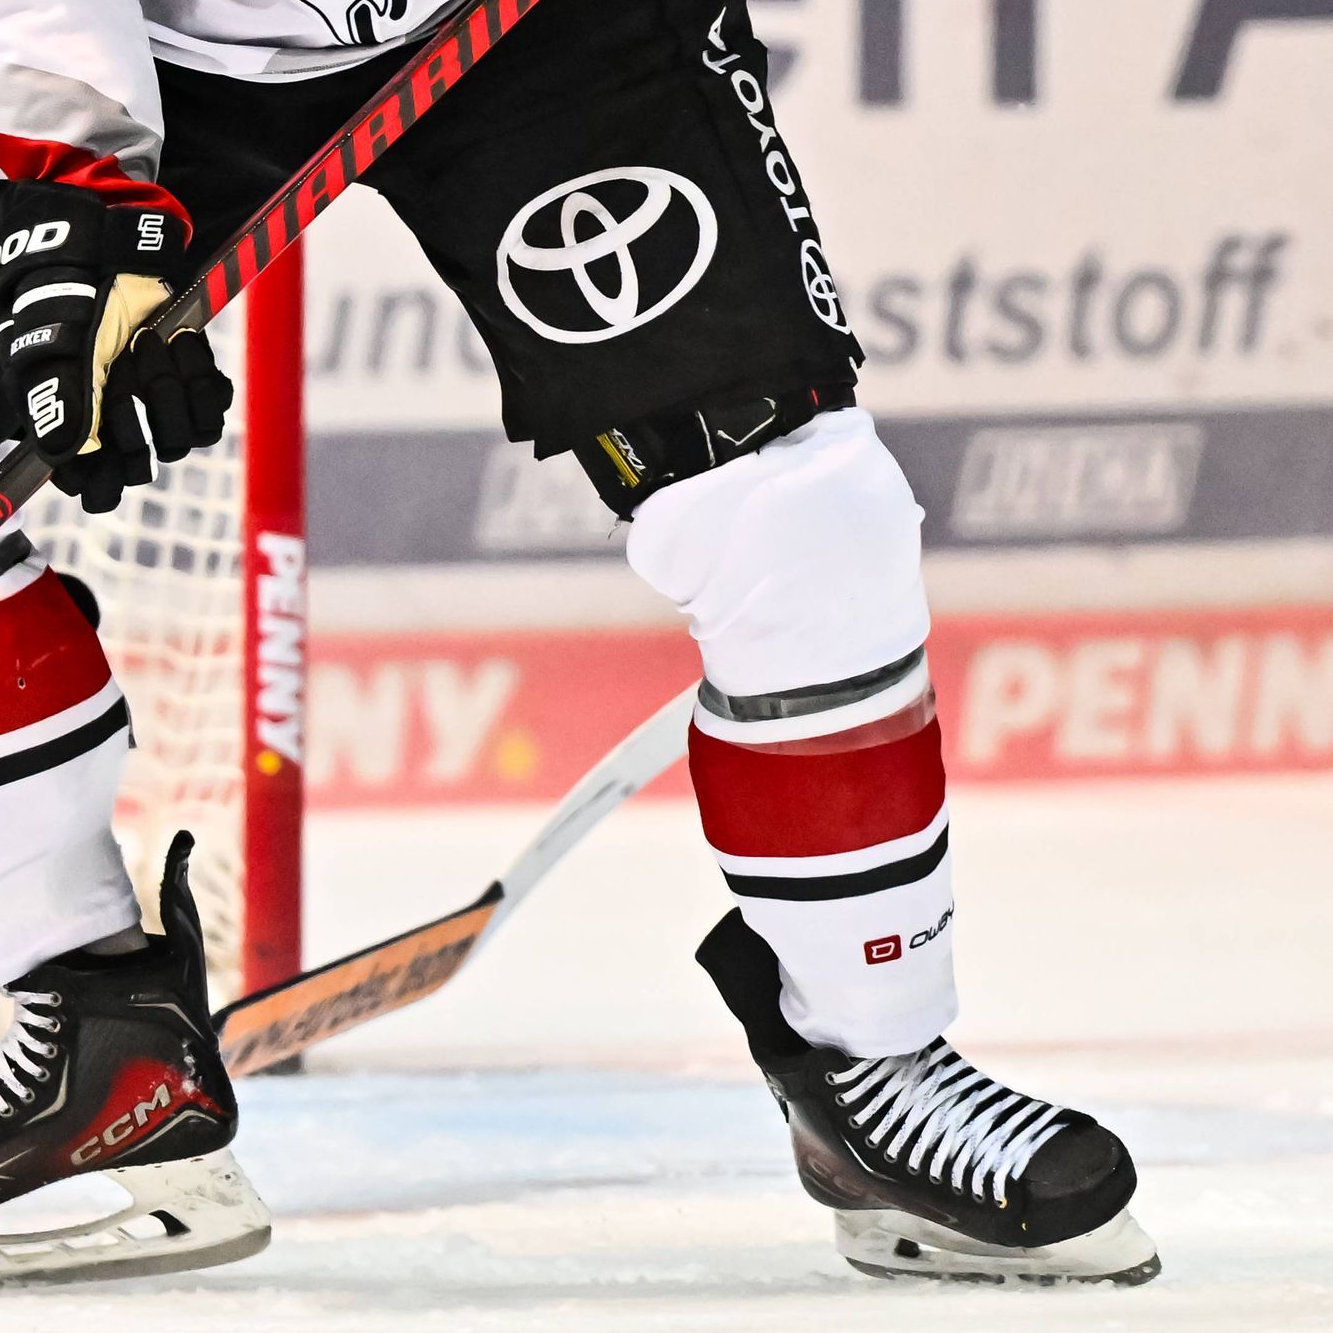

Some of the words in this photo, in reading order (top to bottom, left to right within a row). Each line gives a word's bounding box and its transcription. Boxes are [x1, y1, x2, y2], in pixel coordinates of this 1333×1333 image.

[702, 5, 811, 233] TOYOTA
[863, 231, 1288, 372] ststoff
[961, 635, 1333, 764] PENN
[70, 1082, 173, 1167] CCM
